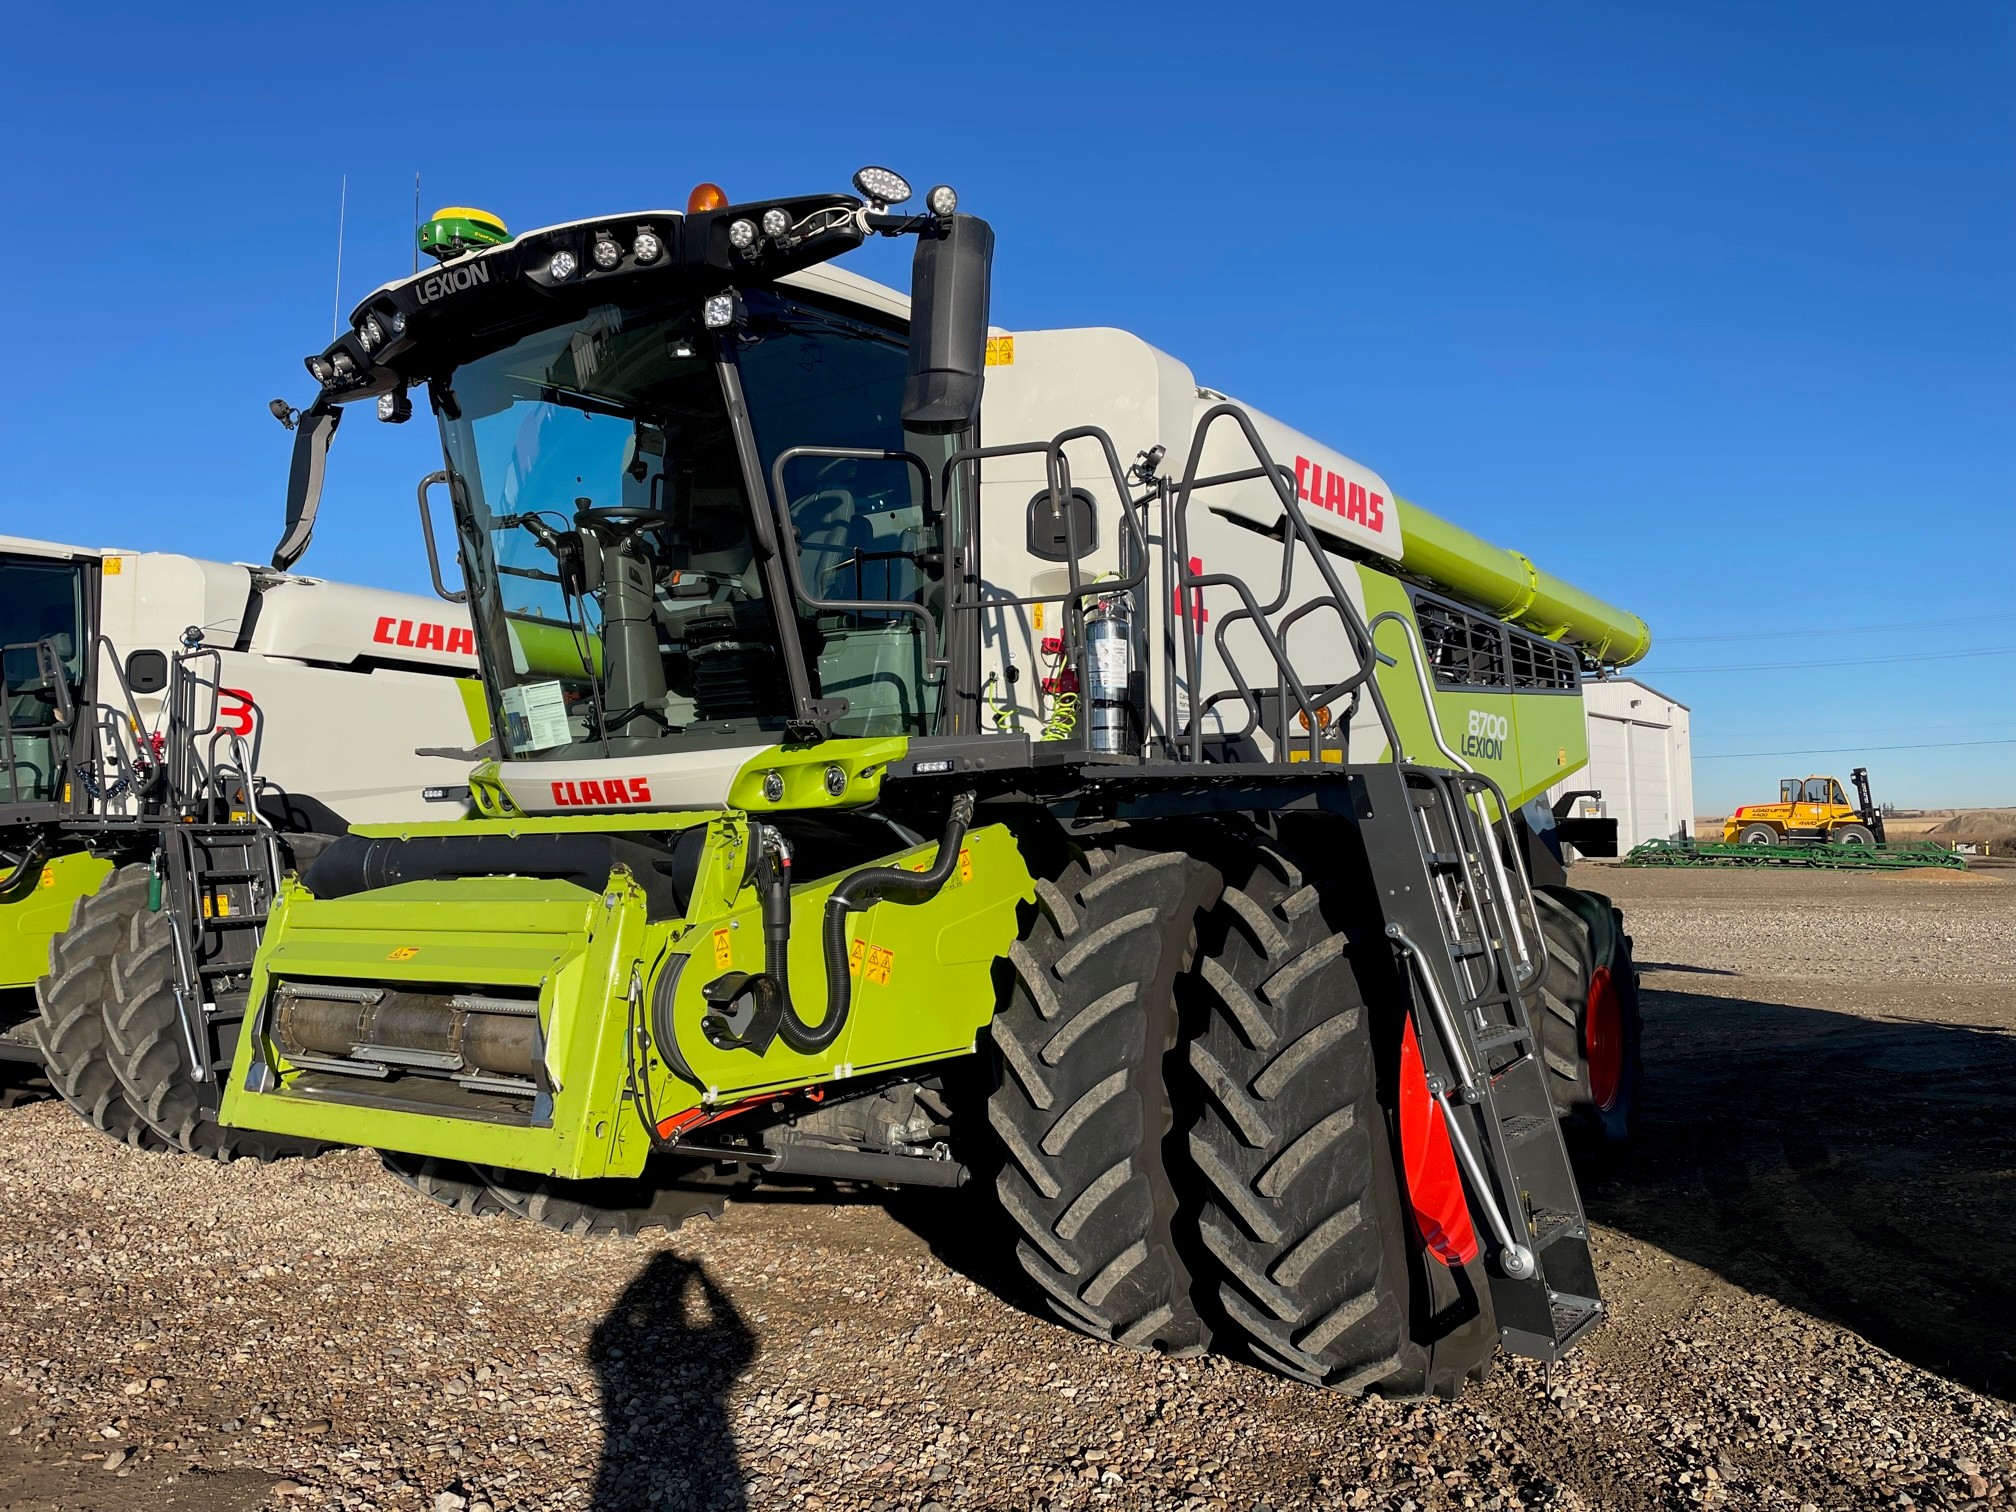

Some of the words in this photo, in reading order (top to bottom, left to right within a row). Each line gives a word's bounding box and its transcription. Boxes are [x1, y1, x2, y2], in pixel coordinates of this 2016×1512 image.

[415, 260, 489, 305] LEXION
[1295, 455, 1383, 533] CLAAS
[1174, 556, 1208, 635] 4
[373, 616, 478, 655] CLAA
[216, 688, 253, 736] 3
[1469, 709, 1507, 741] 8700
[1461, 733, 1502, 761] LEXION
[551, 778, 652, 806] CLAAS
